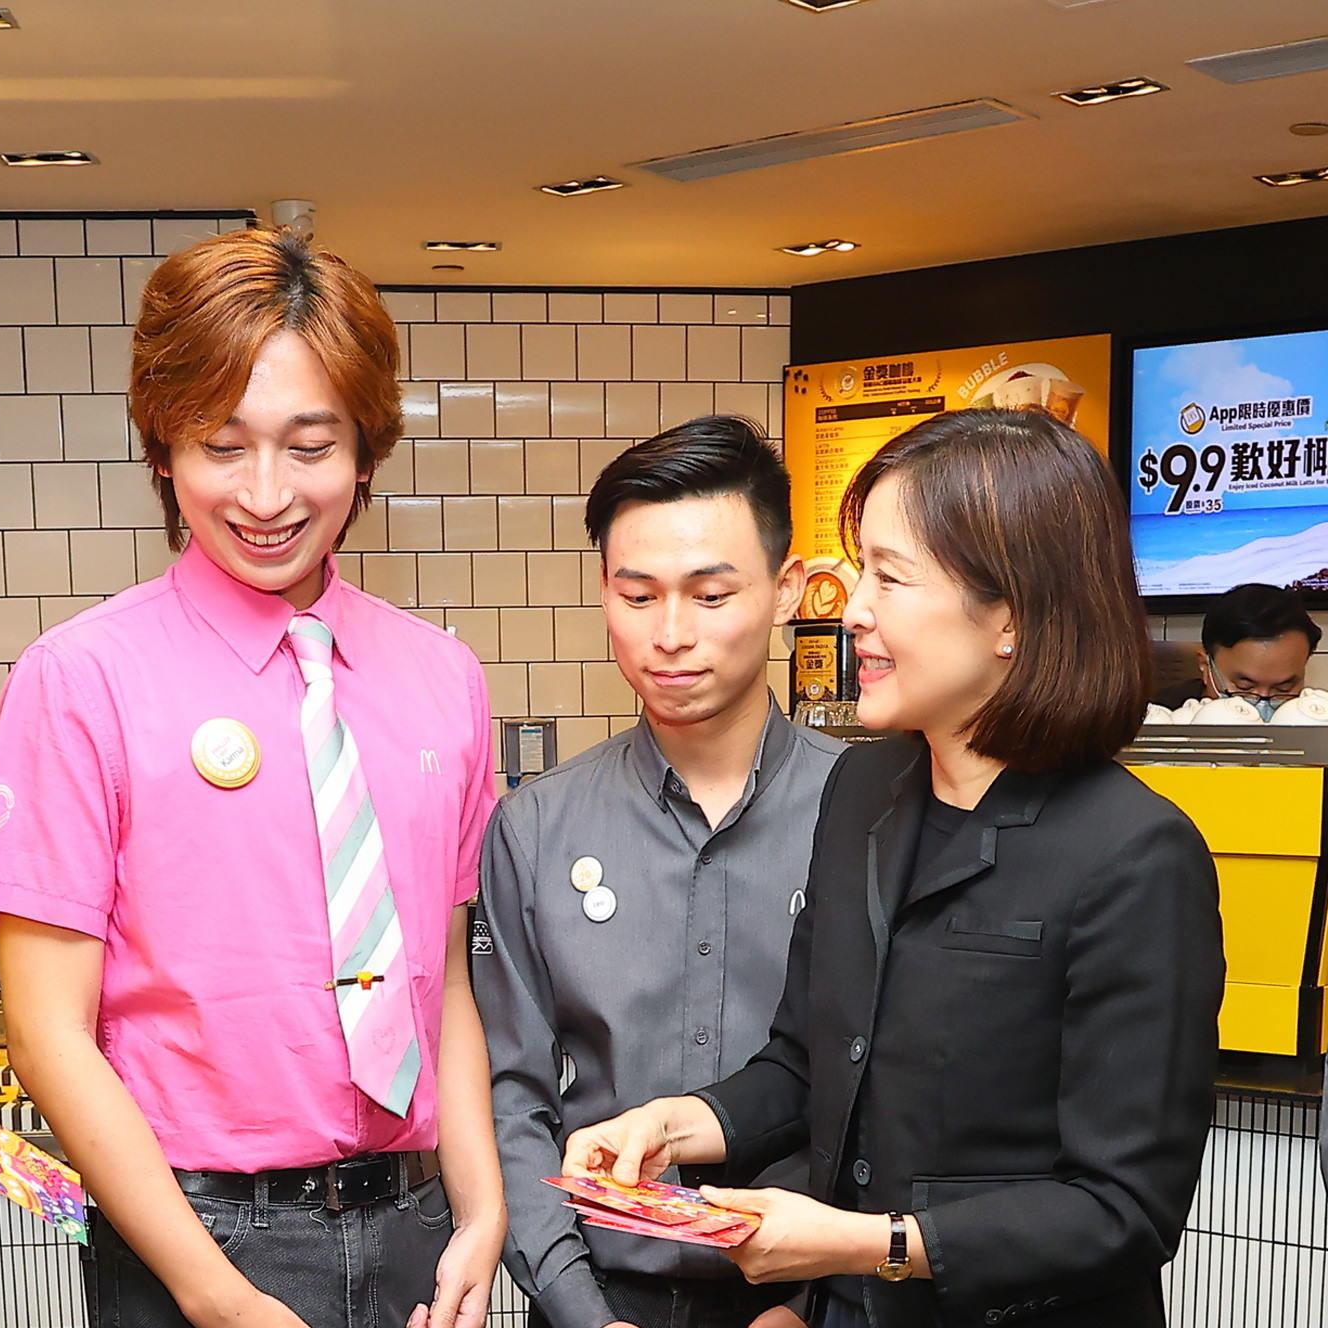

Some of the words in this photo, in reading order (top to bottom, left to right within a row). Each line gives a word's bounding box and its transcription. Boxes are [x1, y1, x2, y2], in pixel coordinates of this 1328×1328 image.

[957, 351, 1008, 401] BUBBLE
[1209, 397, 1311, 426] App限時優惠價
[1221, 422, 1247, 432] Limited
[1248, 421, 1273, 431] Special
[1274, 419, 1292, 428] Price
[1139, 443, 1226, 513] $9.9
[1228, 483, 1245, 491] Enjoy
